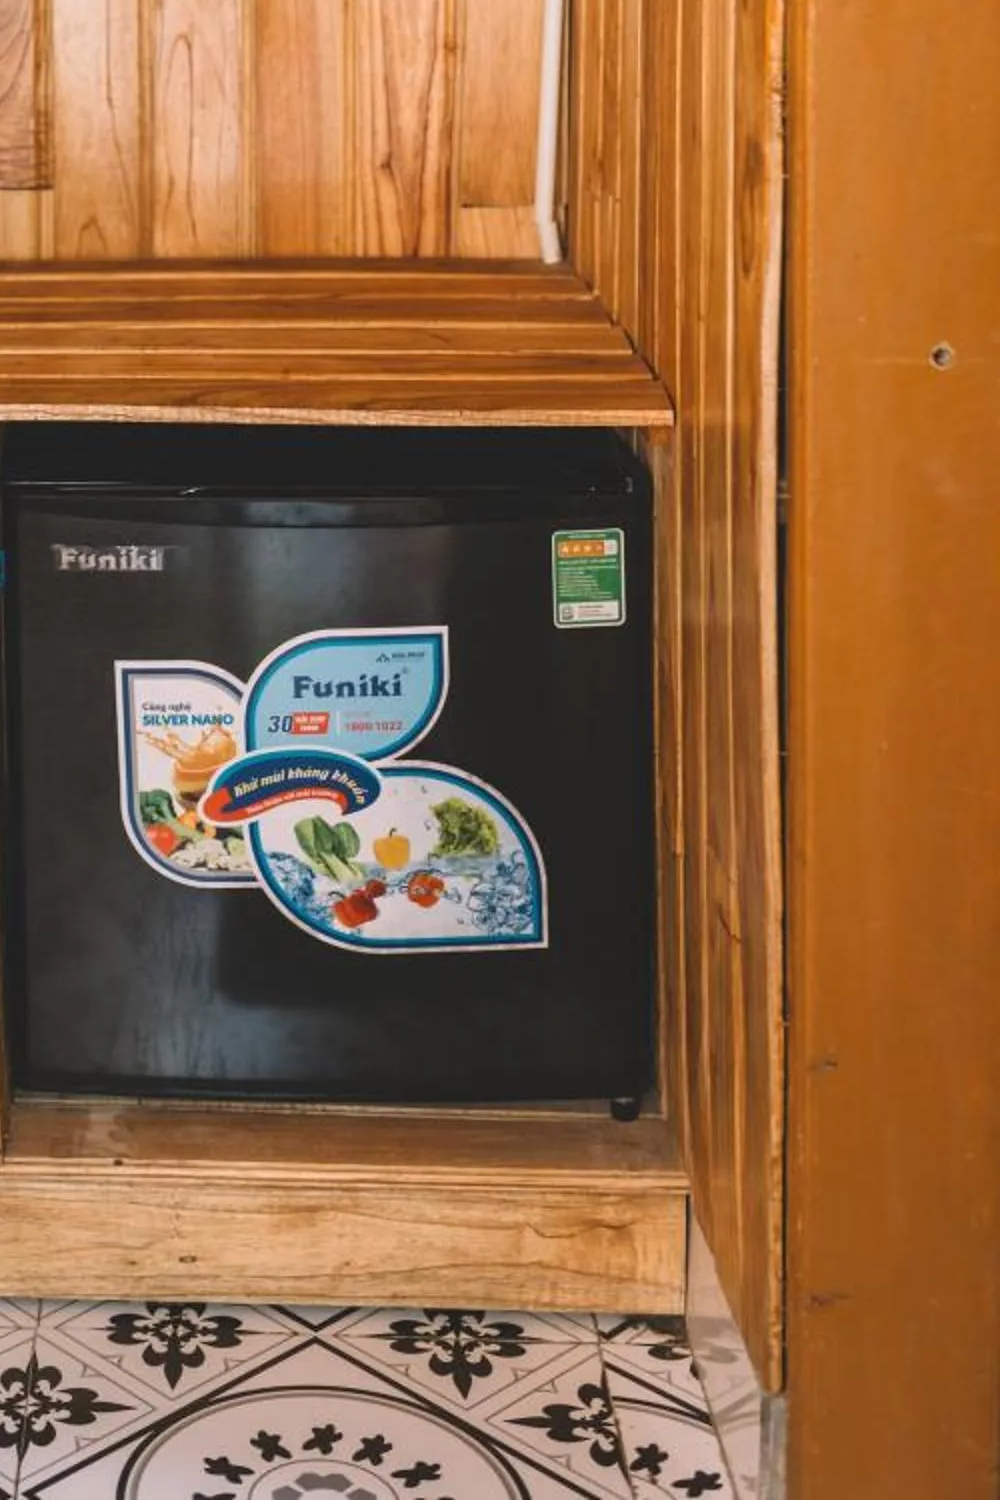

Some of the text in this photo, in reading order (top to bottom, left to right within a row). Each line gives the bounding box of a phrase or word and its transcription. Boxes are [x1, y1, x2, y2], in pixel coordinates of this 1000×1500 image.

[58, 547, 164, 572] Funiki
[292, 673, 403, 699] Funiki
[142, 713, 234, 726] SILVER NANO
[267, 715, 293, 733] 30
